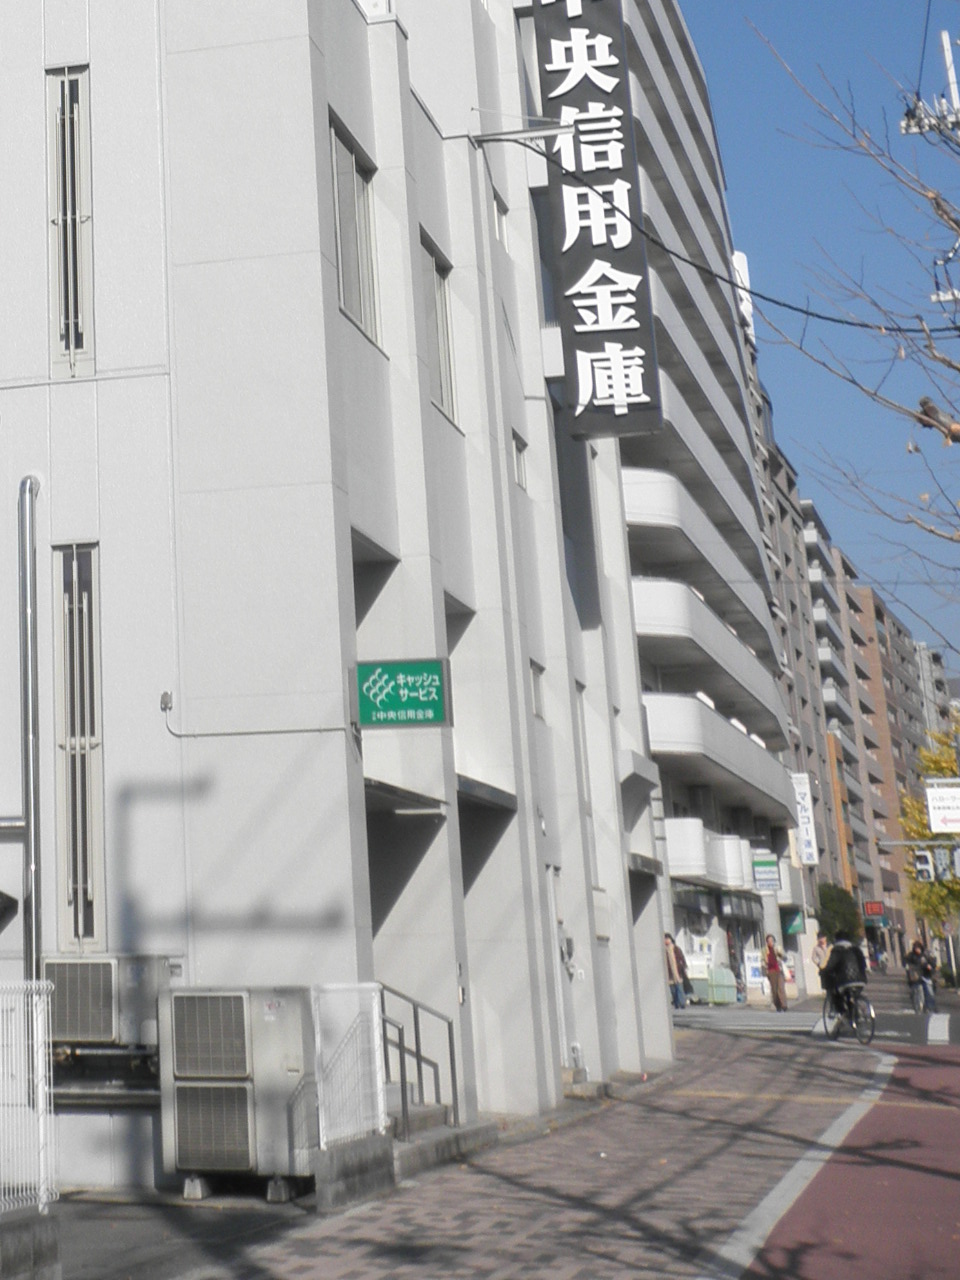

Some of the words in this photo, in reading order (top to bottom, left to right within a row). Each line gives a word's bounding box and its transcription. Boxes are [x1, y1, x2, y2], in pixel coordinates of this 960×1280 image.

[396, 672, 440, 688] キャッシュ
[399, 687, 438, 703] サービス
